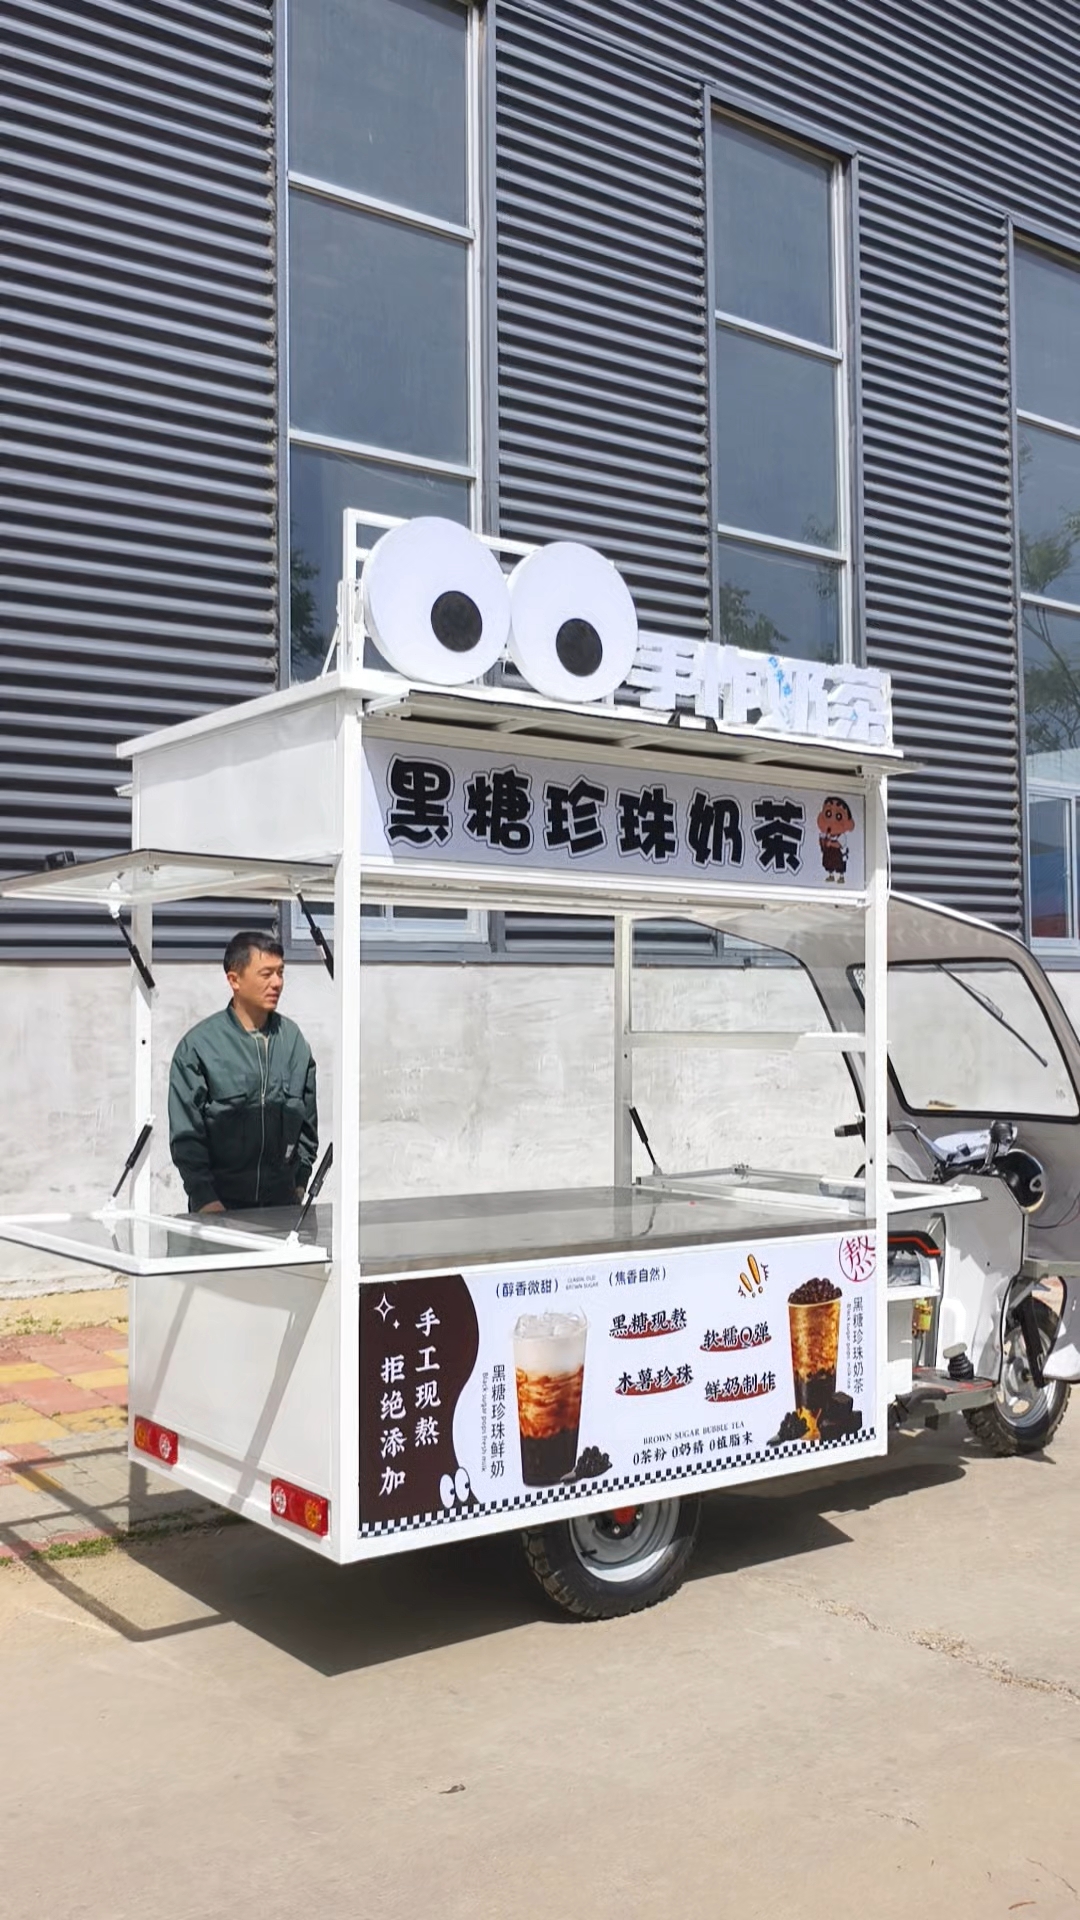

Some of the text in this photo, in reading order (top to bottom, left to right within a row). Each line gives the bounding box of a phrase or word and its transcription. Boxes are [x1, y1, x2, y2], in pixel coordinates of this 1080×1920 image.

[387, 755, 806, 873] 黑糖珍珠奶茶
[609, 1307, 687, 1337] 黑糖现熬
[703, 1321, 770, 1349] 软糯Q弹
[852, 1296, 864, 1394] 黑糖珍珠奶茶
[415, 1306, 441, 1447] 手工现熬
[618, 1363, 694, 1394] 木薯珍珠
[704, 1371, 776, 1401] 鲜奶制作
[379, 1354, 408, 1497] 拒绝添加
[490, 1364, 506, 1479] 黑糖珍珠鲜奶
[643, 1420, 745, 1445] BROWN SUGAR BUBBLE TEA
[633, 1447, 667, 1465] 0茶粉
[709, 1430, 753, 1451] 0植脂末
